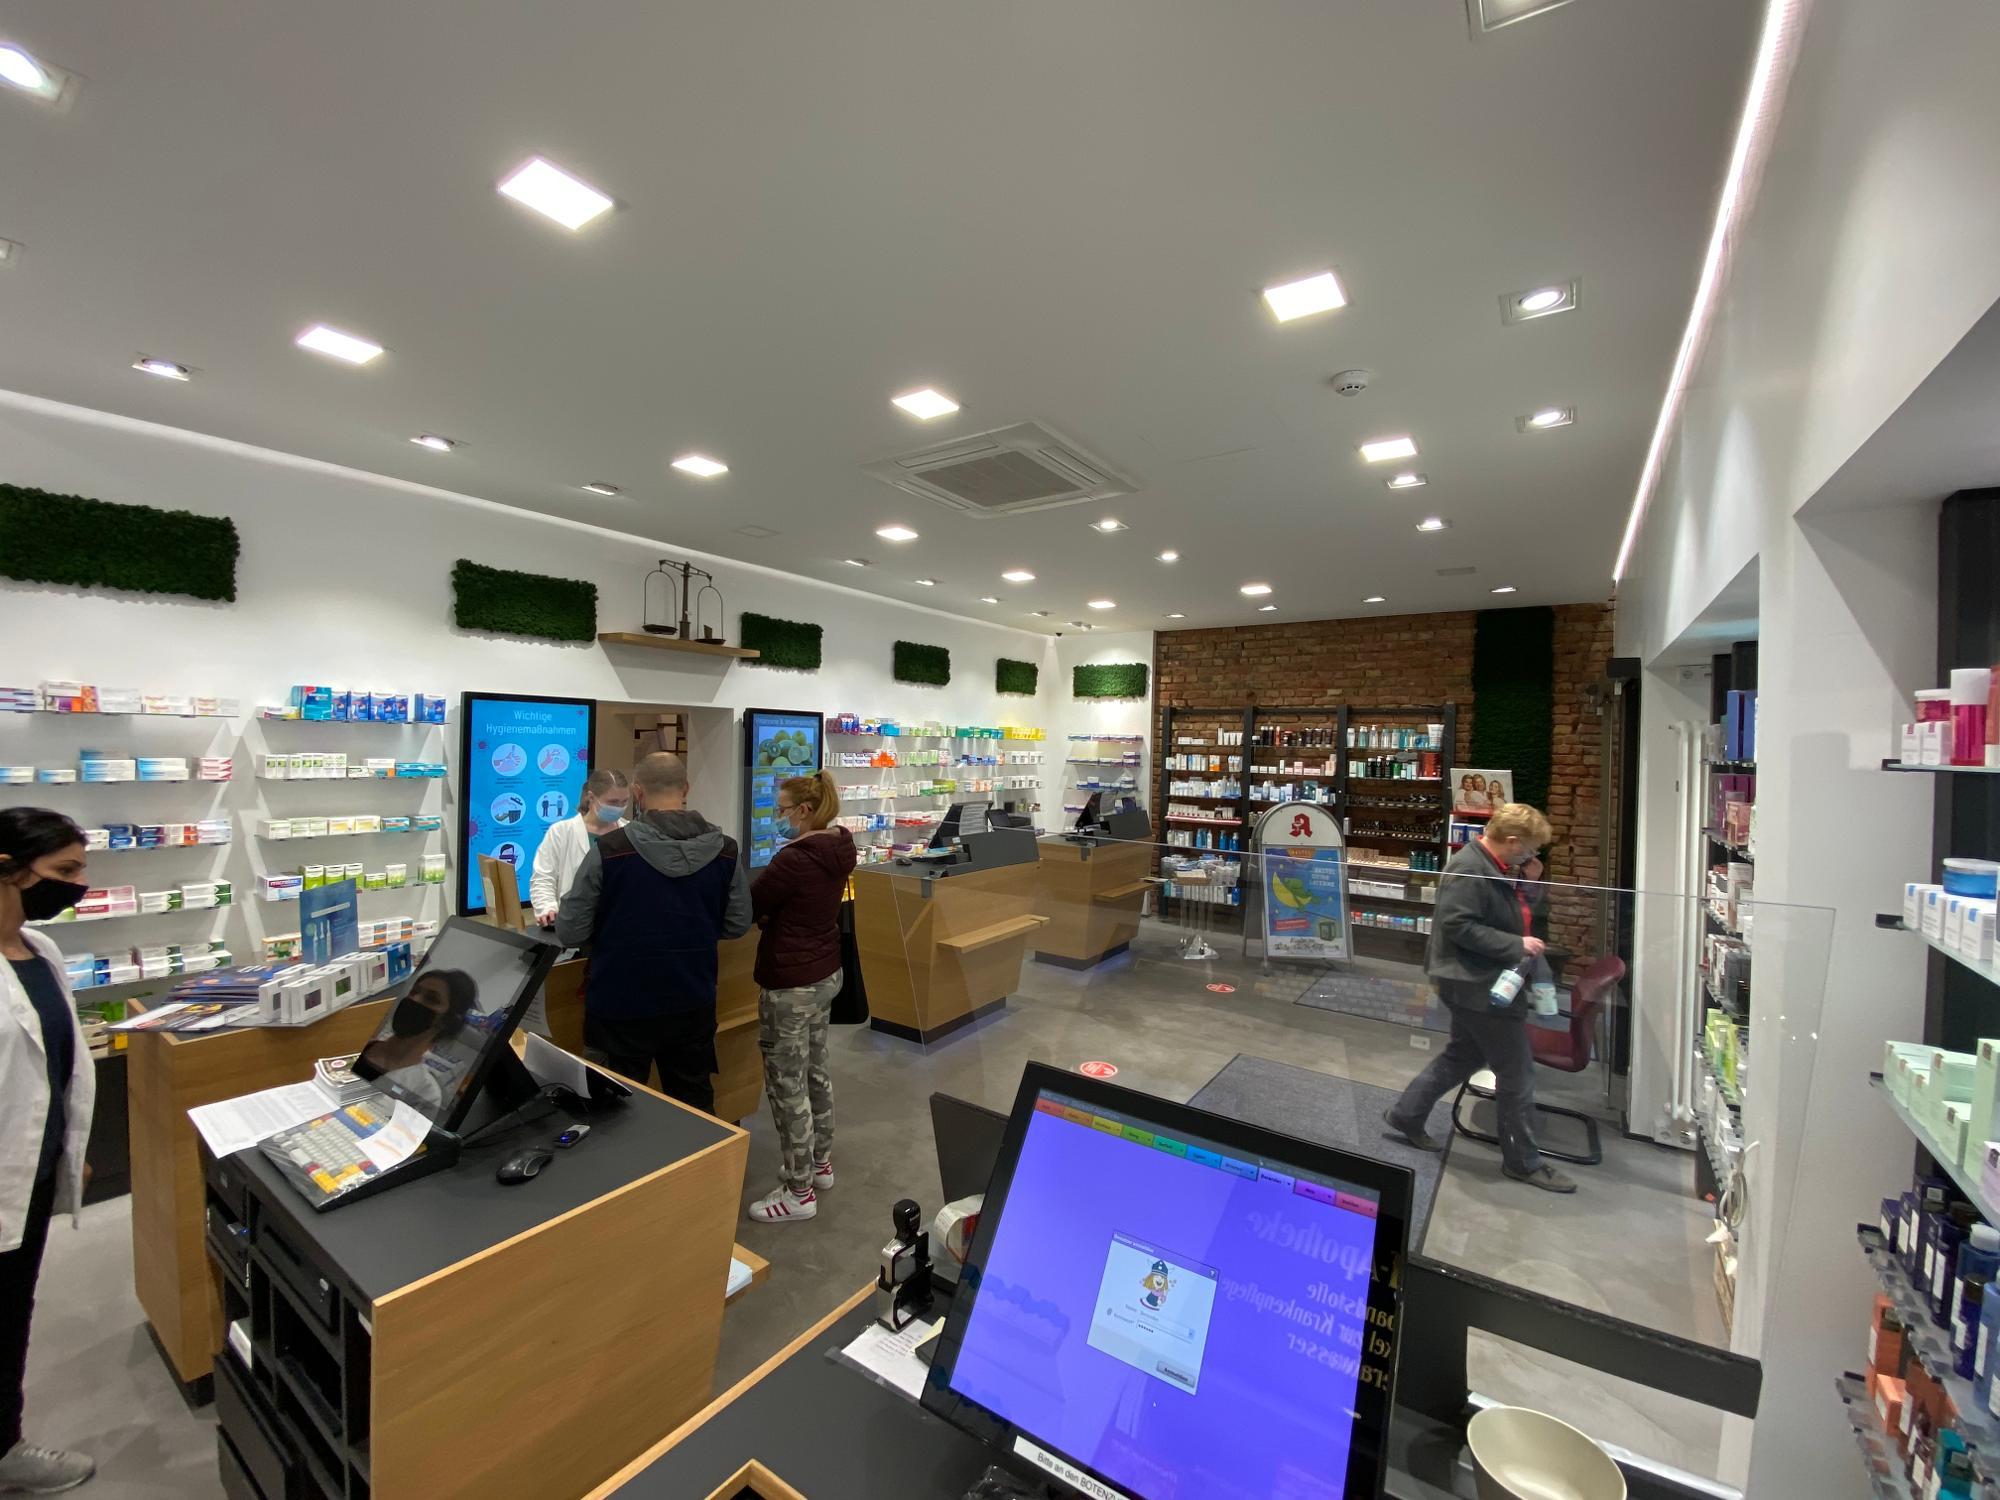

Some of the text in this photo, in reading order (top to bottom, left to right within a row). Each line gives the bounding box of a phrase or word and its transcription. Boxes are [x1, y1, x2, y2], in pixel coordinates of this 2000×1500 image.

[513, 710, 552, 723] Wichtige
[486, 723, 576, 736] Hygienemaßnahmen
[1037, 1452, 1054, 1469] Bitte
[1054, 1463, 1064, 1475] an
[1064, 1469, 1079, 1483] den
